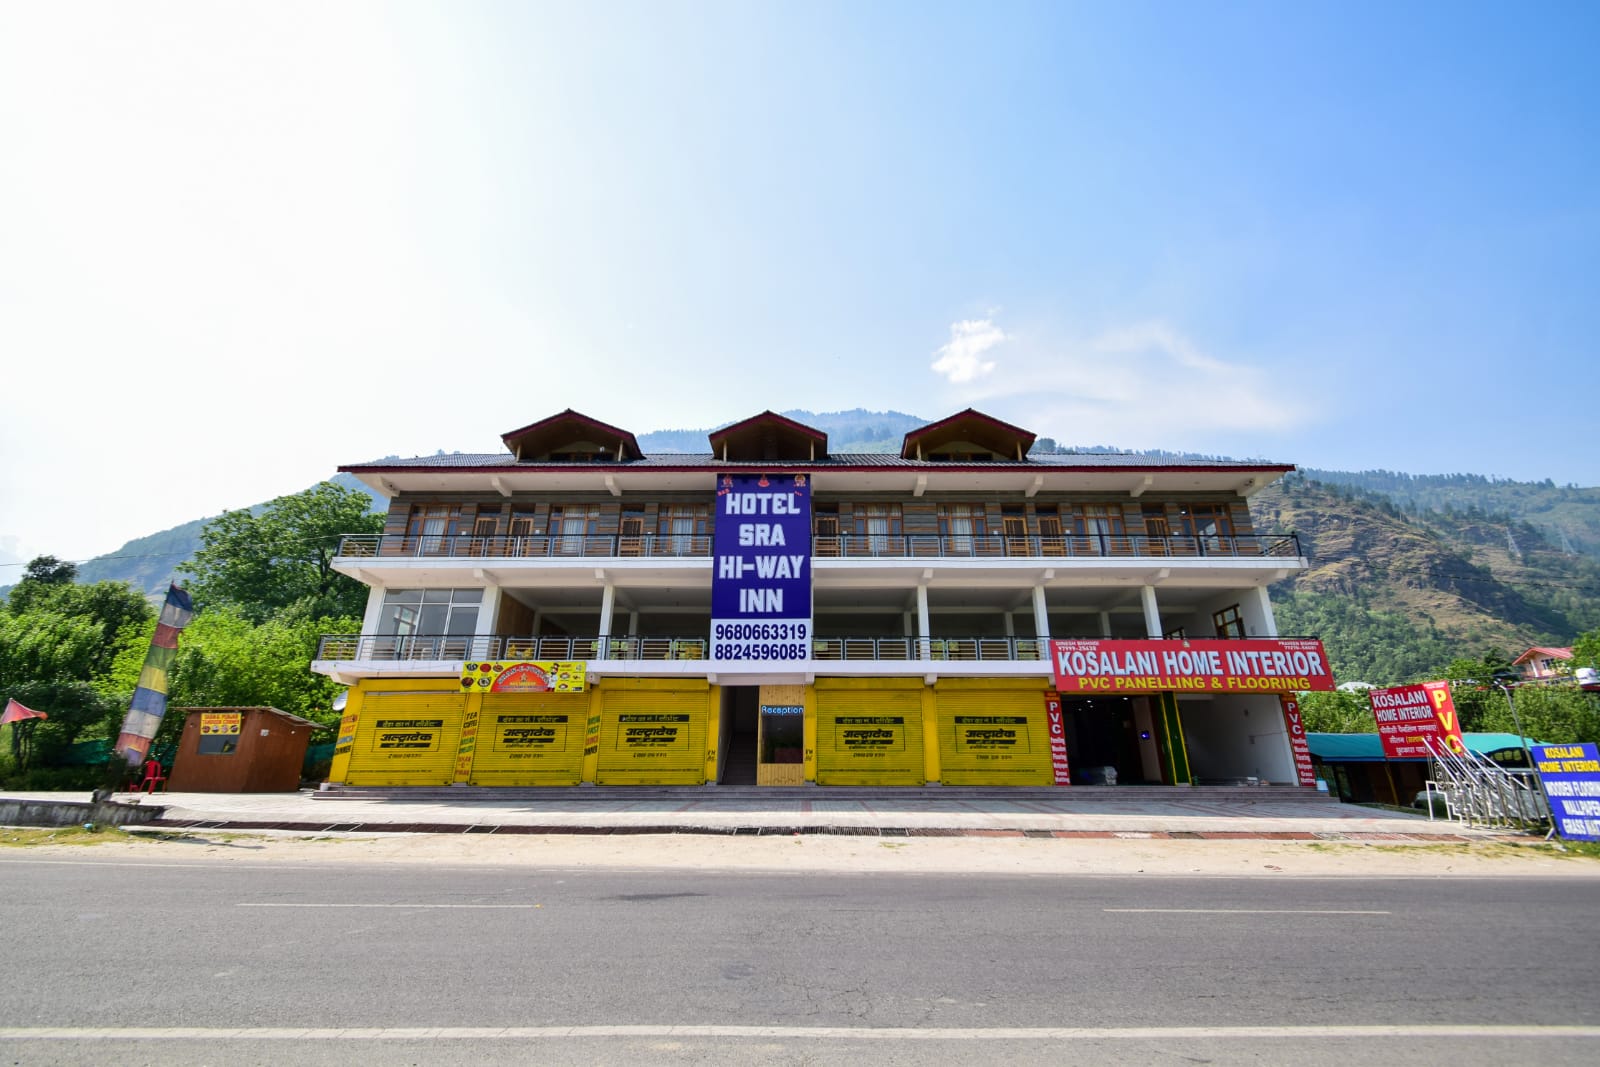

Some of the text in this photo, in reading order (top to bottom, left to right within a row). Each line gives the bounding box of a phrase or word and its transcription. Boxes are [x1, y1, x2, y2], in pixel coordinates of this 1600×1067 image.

[725, 493, 801, 515] HOTEL
[739, 523, 786, 546] SRA
[719, 555, 805, 579] HI-WAY
[739, 588, 783, 613] INN
[715, 624, 807, 640] 9680663319
[715, 644, 807, 660] 8824596085
[1057, 651, 1326, 676] KOSALANI HOME INTERIOR
[1078, 677, 1311, 689] PVC PANELLING & FLOORING
[1372, 690, 1428, 708] KOSALANI
[466, 712, 478, 720] TEA
[761, 706, 804, 717] Reception
[1049, 702, 1062, 735] PVC
[1287, 702, 1302, 735] PVC
[1375, 705, 1434, 722] HOME INTERIOR
[1543, 746, 1585, 759] KOSALANI
[1537, 761, 1563, 773] HOME
